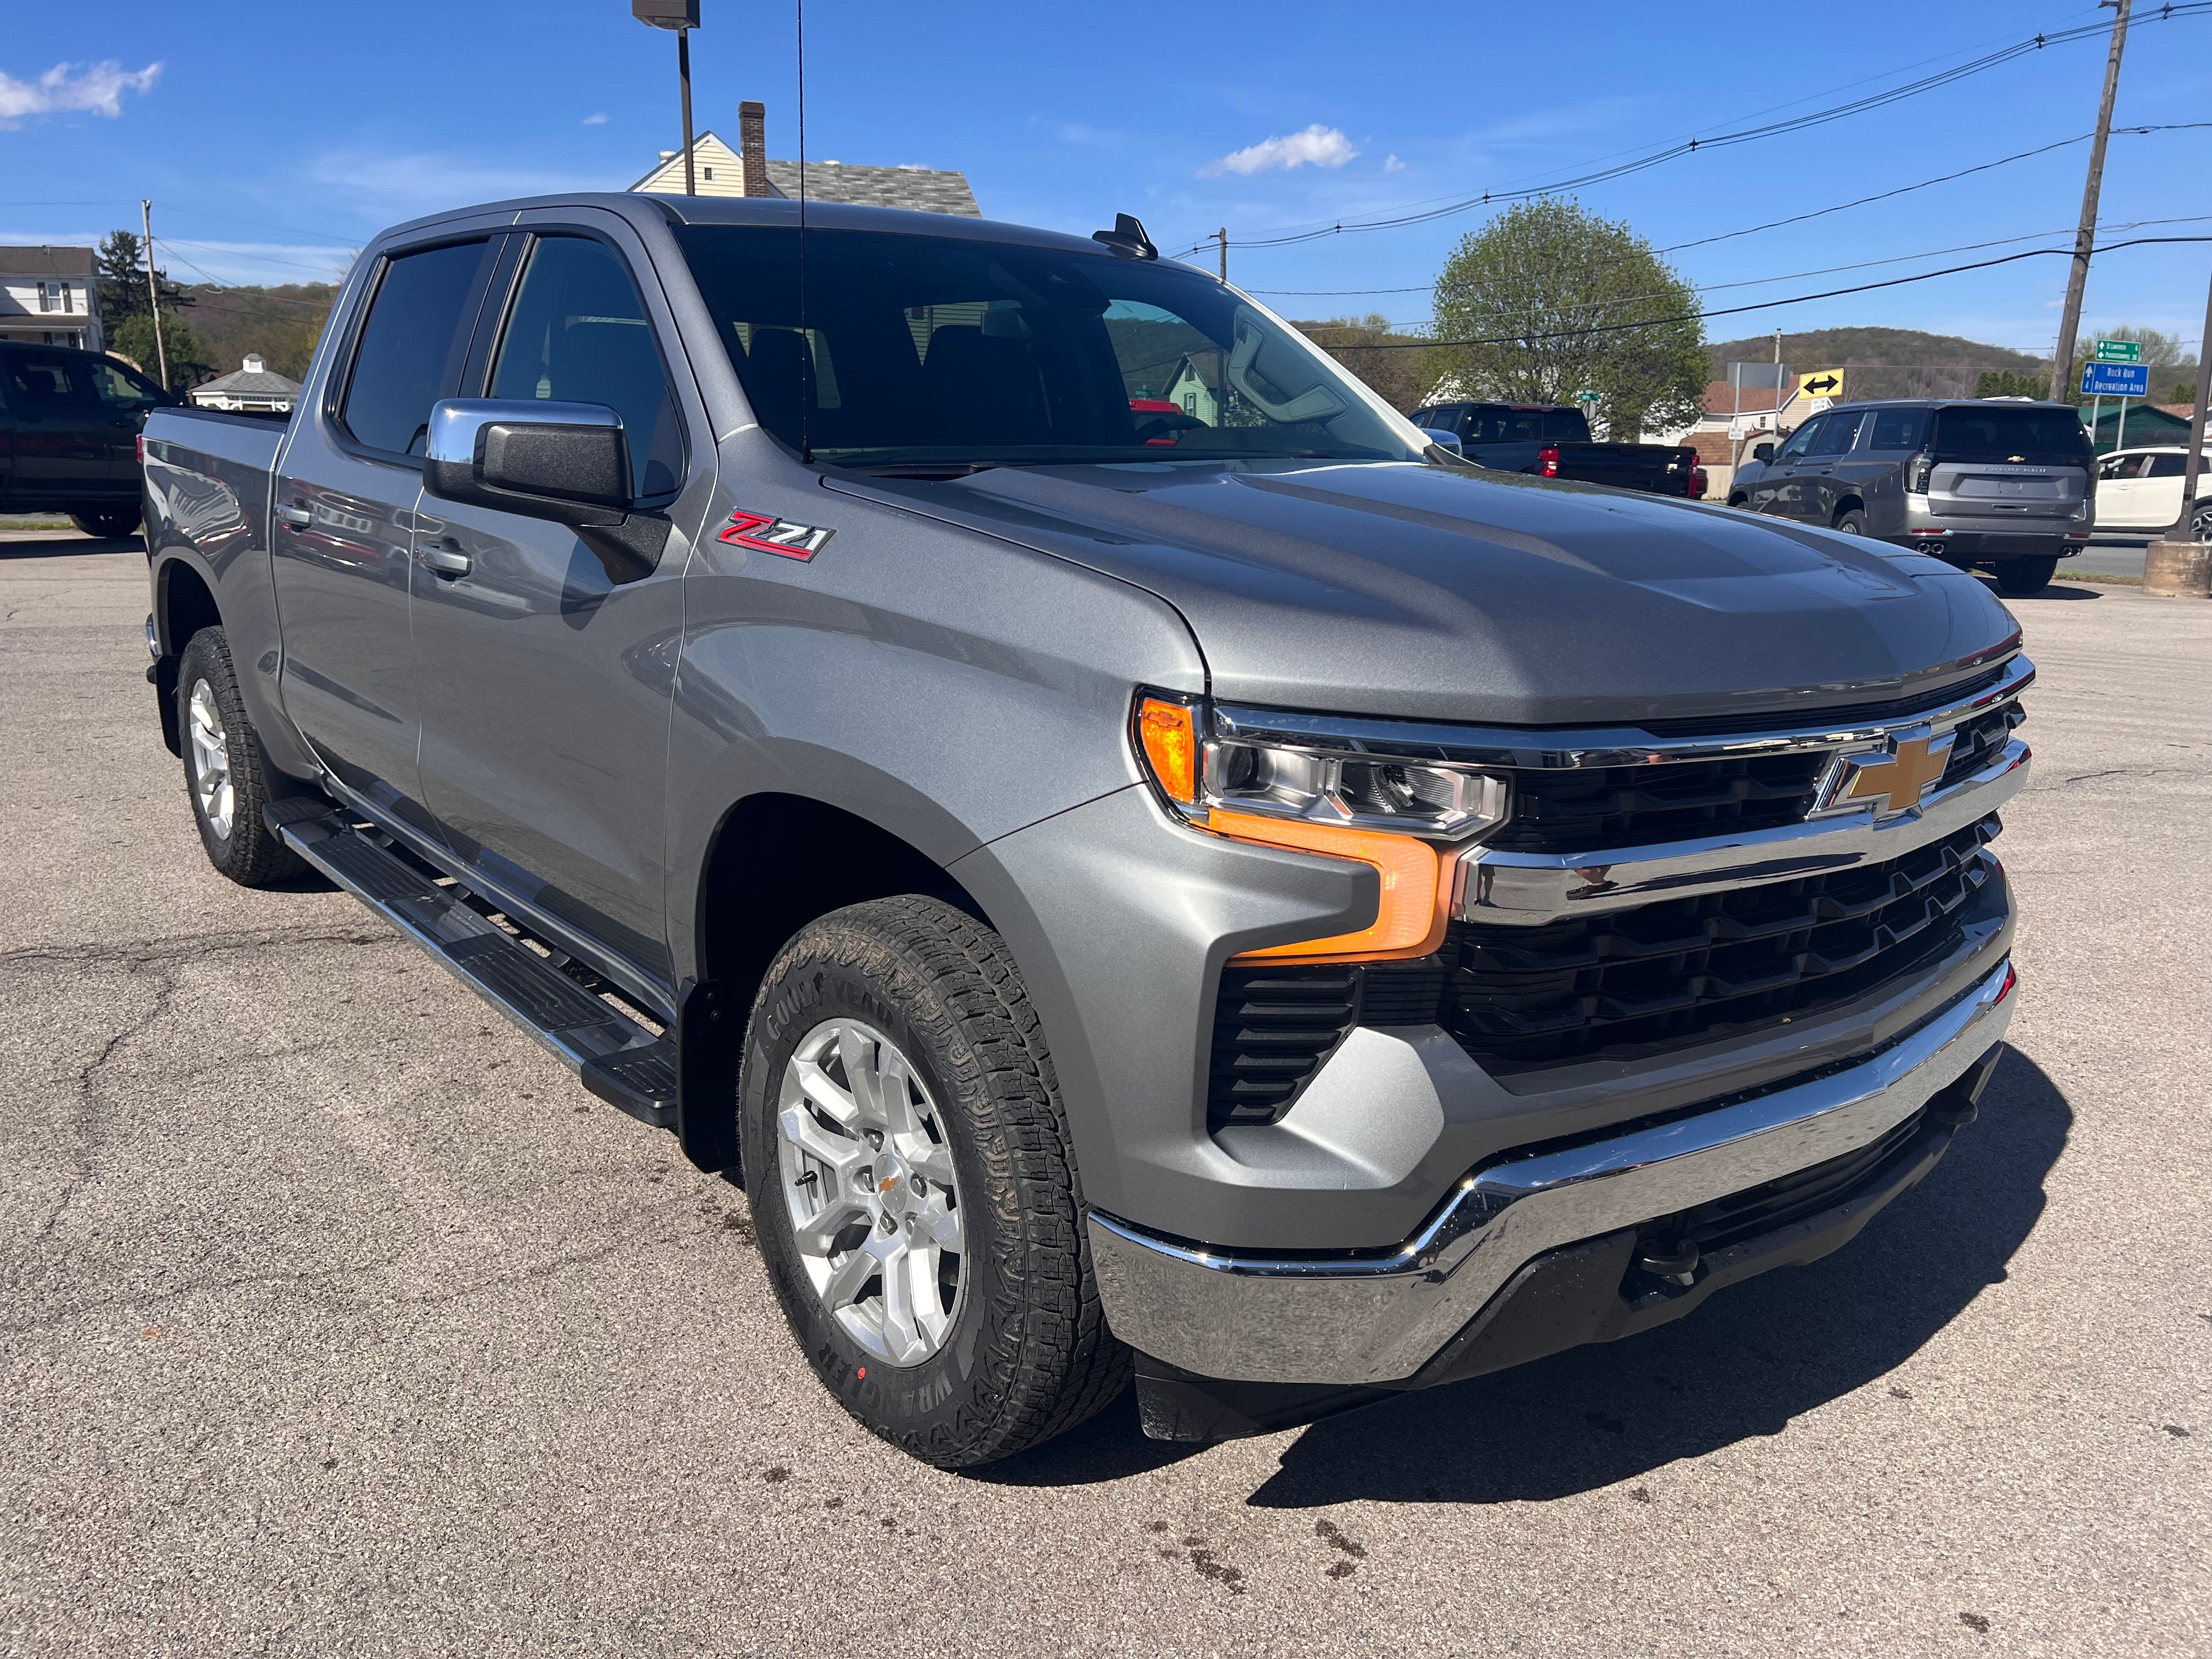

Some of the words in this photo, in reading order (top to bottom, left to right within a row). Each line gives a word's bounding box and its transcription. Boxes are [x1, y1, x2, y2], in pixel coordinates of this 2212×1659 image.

[2107, 367, 2121, 377] Rock
[2123, 368, 2135, 378] Run
[2085, 381, 2089, 390] 4
[2095, 381, 2128, 391] Recreation
[2129, 383, 2144, 393] Area
[715, 506, 837, 563] Z71
